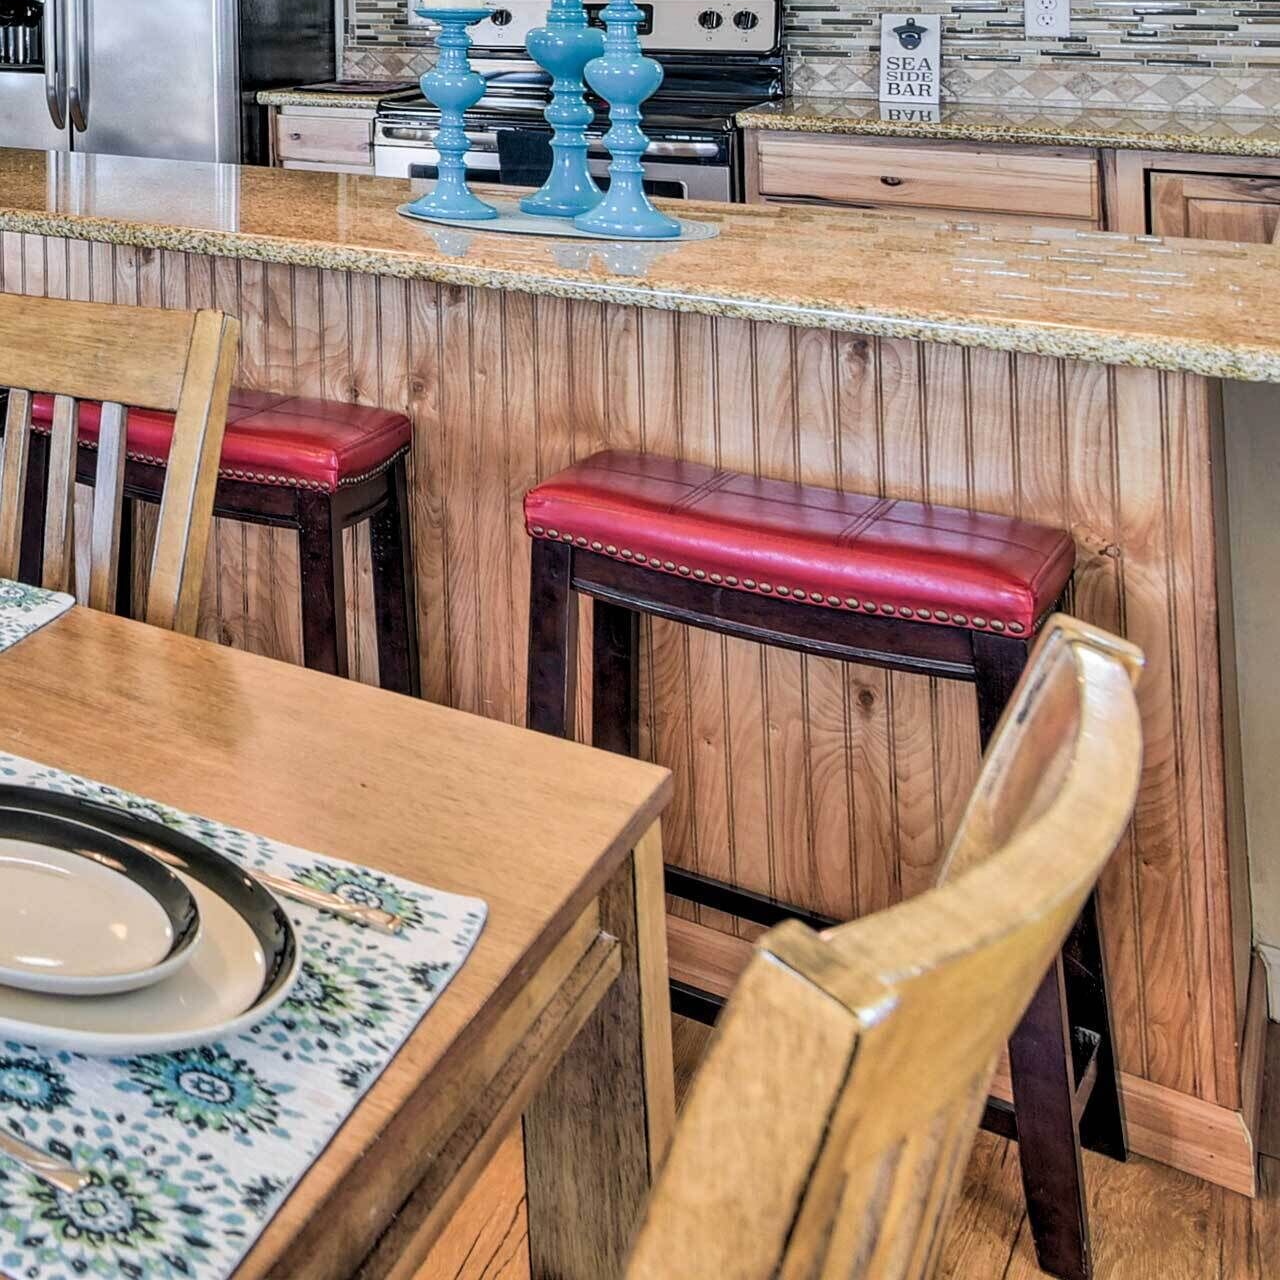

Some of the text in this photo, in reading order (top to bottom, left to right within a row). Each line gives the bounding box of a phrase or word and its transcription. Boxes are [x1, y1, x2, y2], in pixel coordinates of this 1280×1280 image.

[886, 56, 932, 71] SEA
[886, 71, 933, 82] SIDE
[888, 82, 932, 97] BAR
